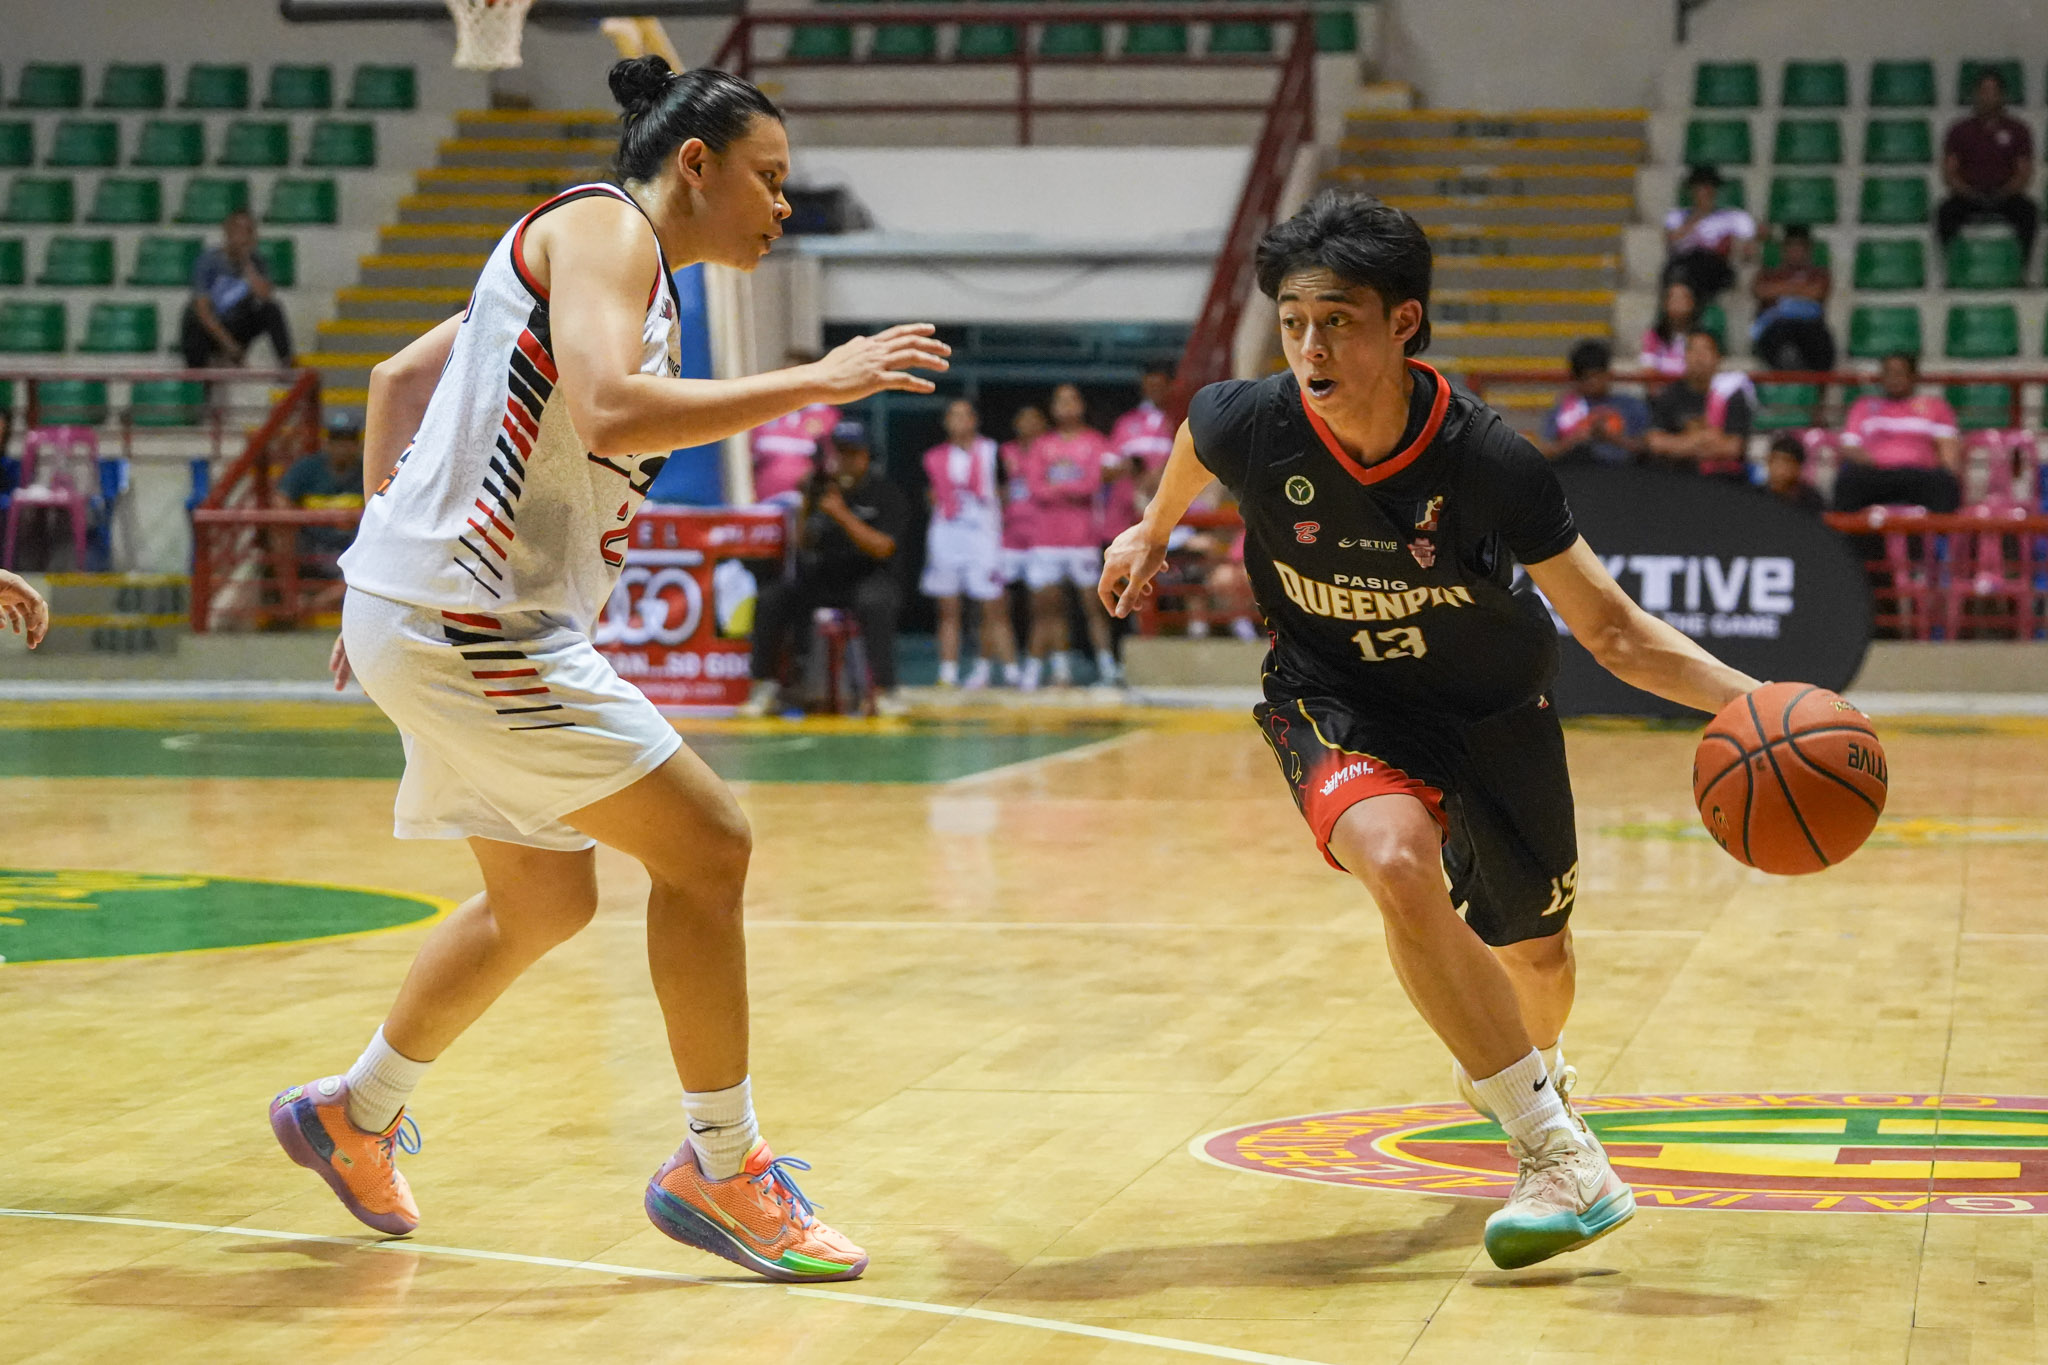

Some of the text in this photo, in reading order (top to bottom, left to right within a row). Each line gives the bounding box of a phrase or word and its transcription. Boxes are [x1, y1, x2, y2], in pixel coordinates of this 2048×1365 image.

[1272, 559, 1476, 622] QUEENPIN
[1333, 573, 1408, 591] PASIG
[1350, 625, 1429, 663] 13
[1334, 761, 1373, 785] MNL
[1569, 1094, 1998, 1109] INGKOD
[1349, 1173, 2034, 1212] GALIN AT
